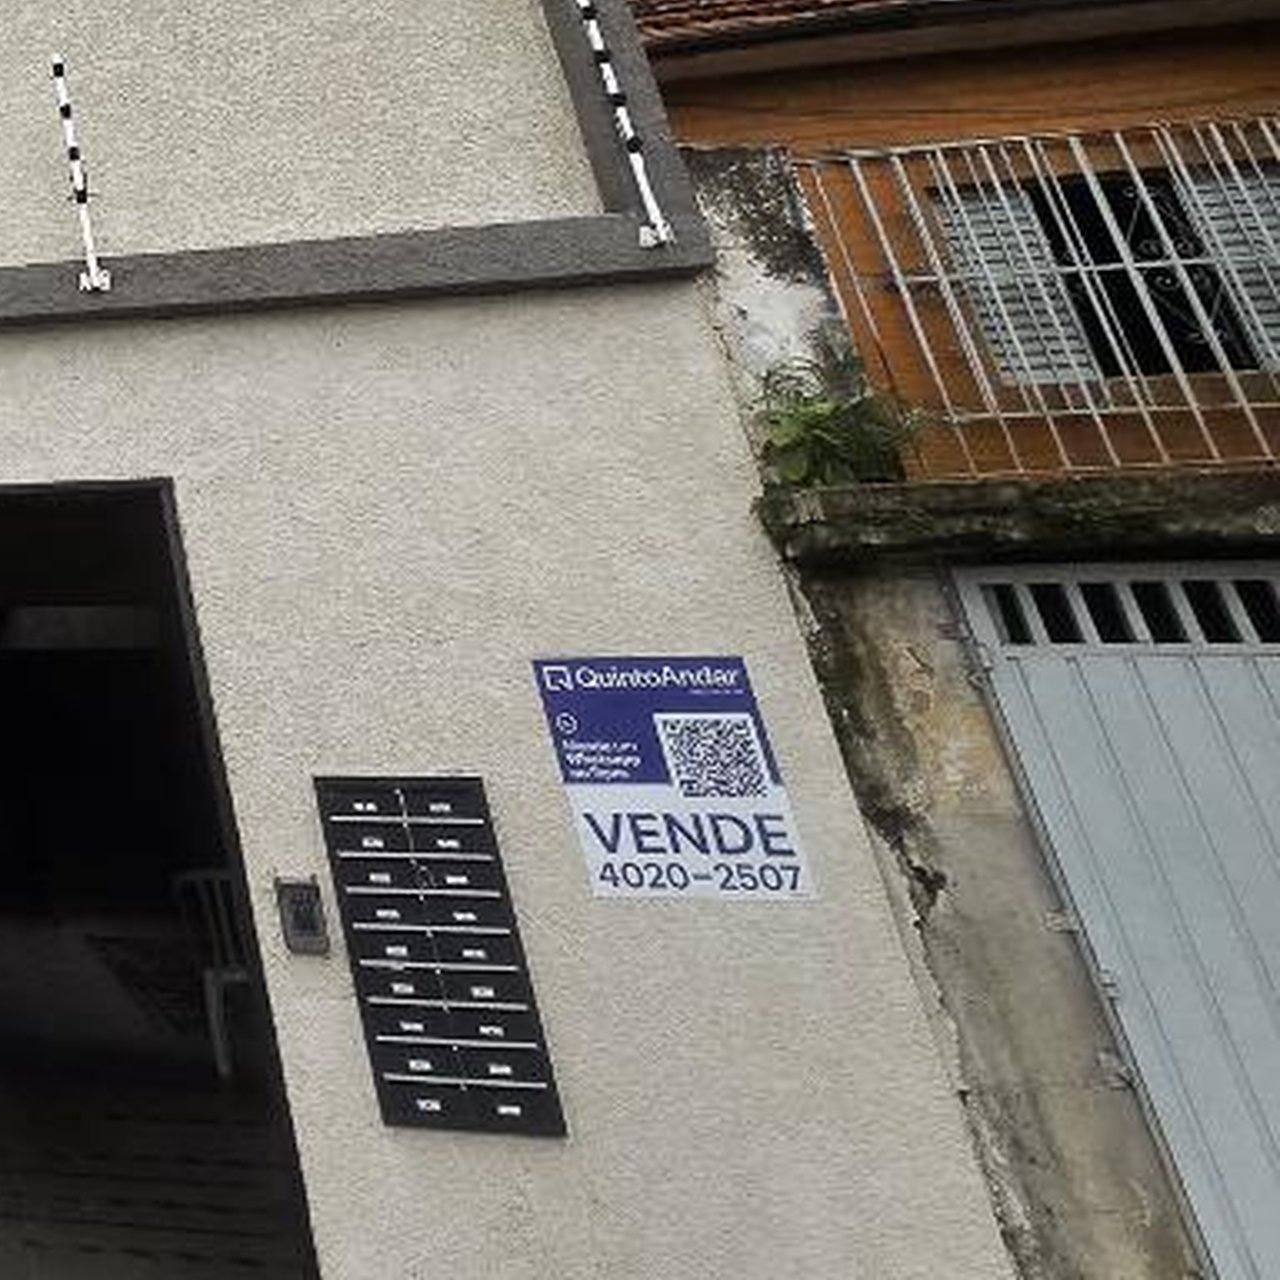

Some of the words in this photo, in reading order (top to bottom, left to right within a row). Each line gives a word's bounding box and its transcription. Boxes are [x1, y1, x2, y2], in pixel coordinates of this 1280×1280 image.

[574, 665, 741, 690] QuintoAndar
[584, 812, 796, 857] VENDE
[598, 862, 802, 891] 4020-2507
